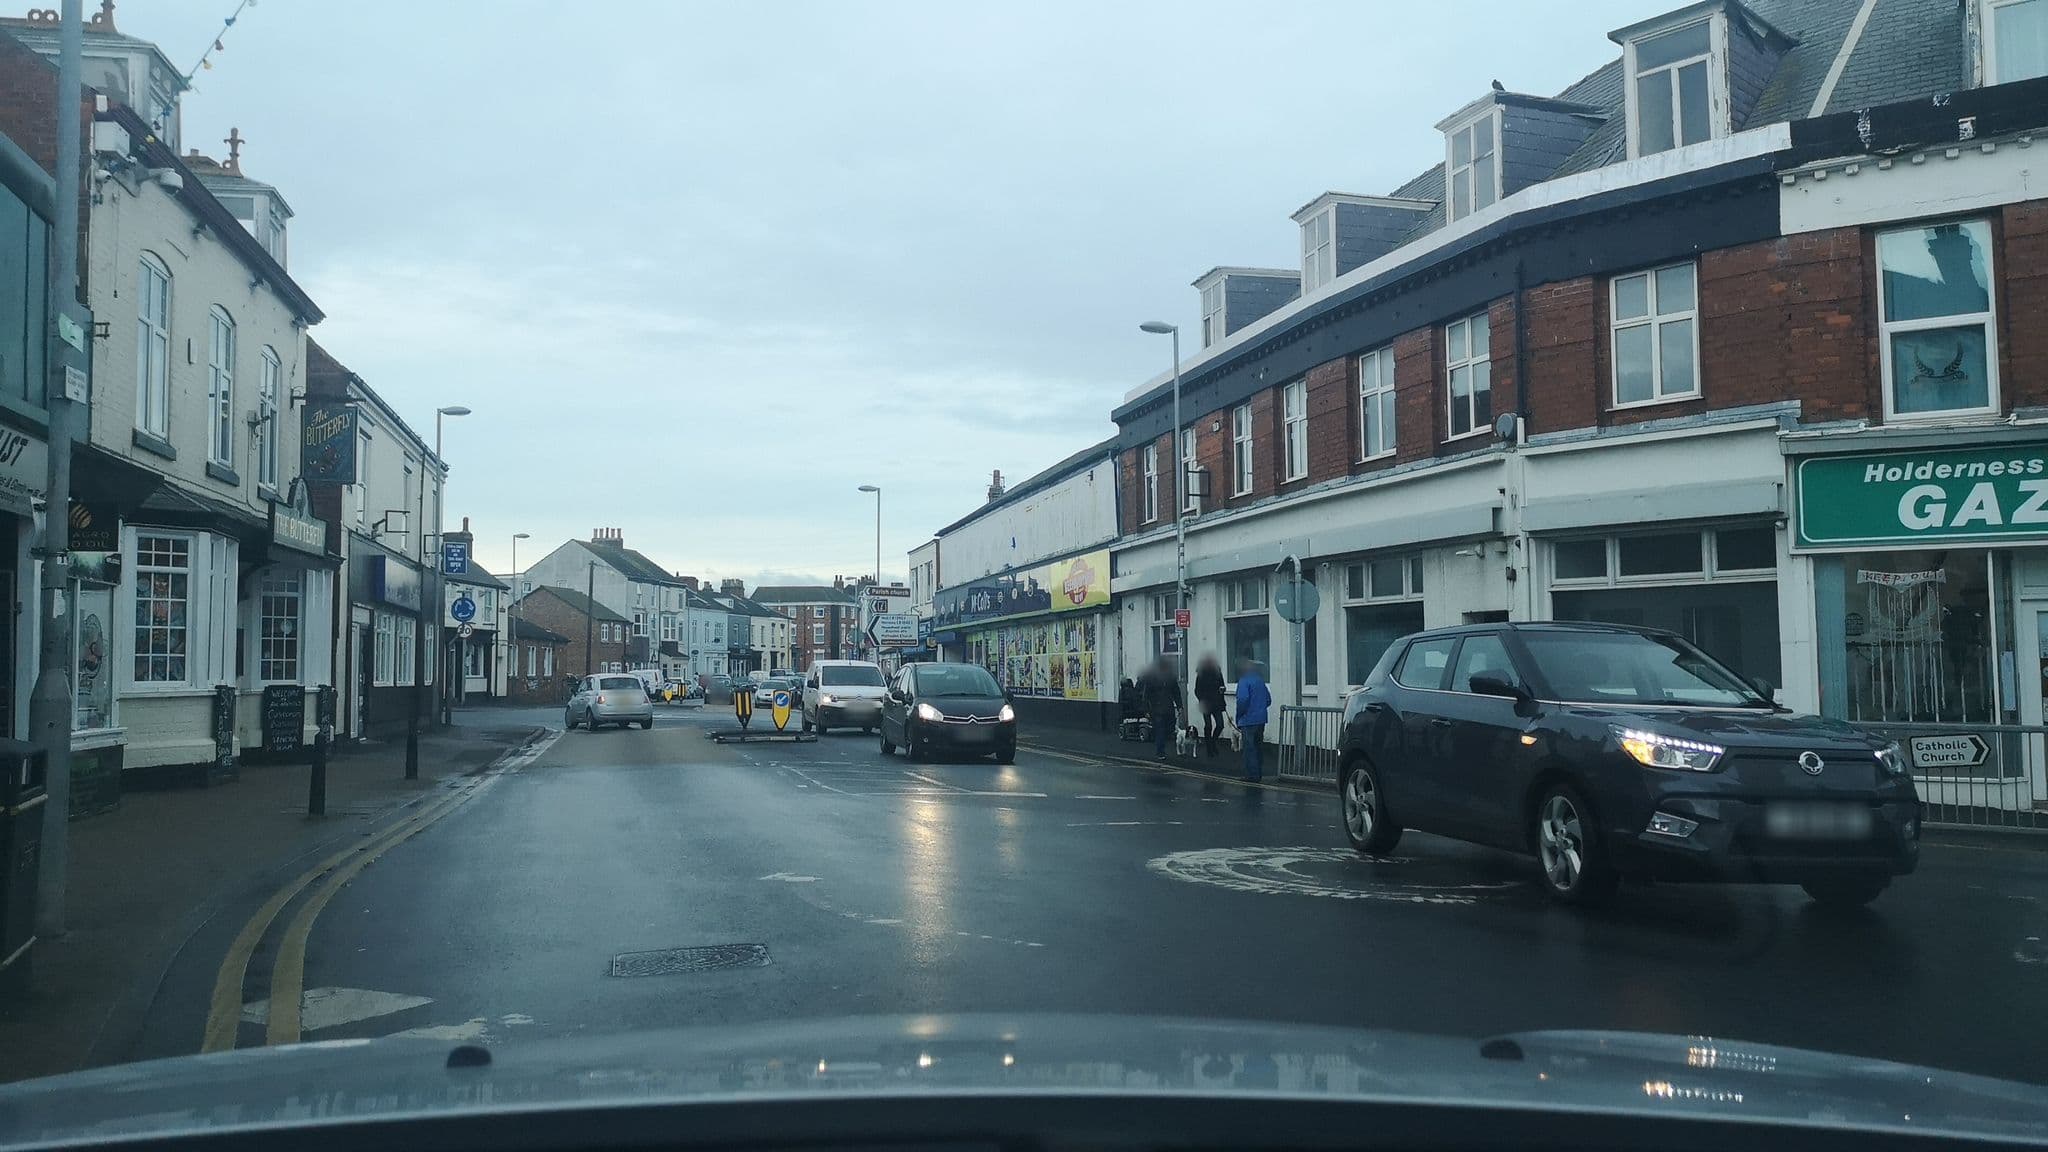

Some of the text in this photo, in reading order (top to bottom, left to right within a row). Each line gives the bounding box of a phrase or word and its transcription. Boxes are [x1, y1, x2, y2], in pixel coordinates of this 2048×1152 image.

[311, 409, 329, 427] The
[306, 412, 352, 446] BUTTERFLY
[1864, 458, 2044, 483] Holderness
[275, 512, 323, 547] THE BUTTERFLY
[872, 588, 910, 596] Parish church
[1916, 740, 1968, 751] Catholic
[1921, 752, 1965, 762] Church
